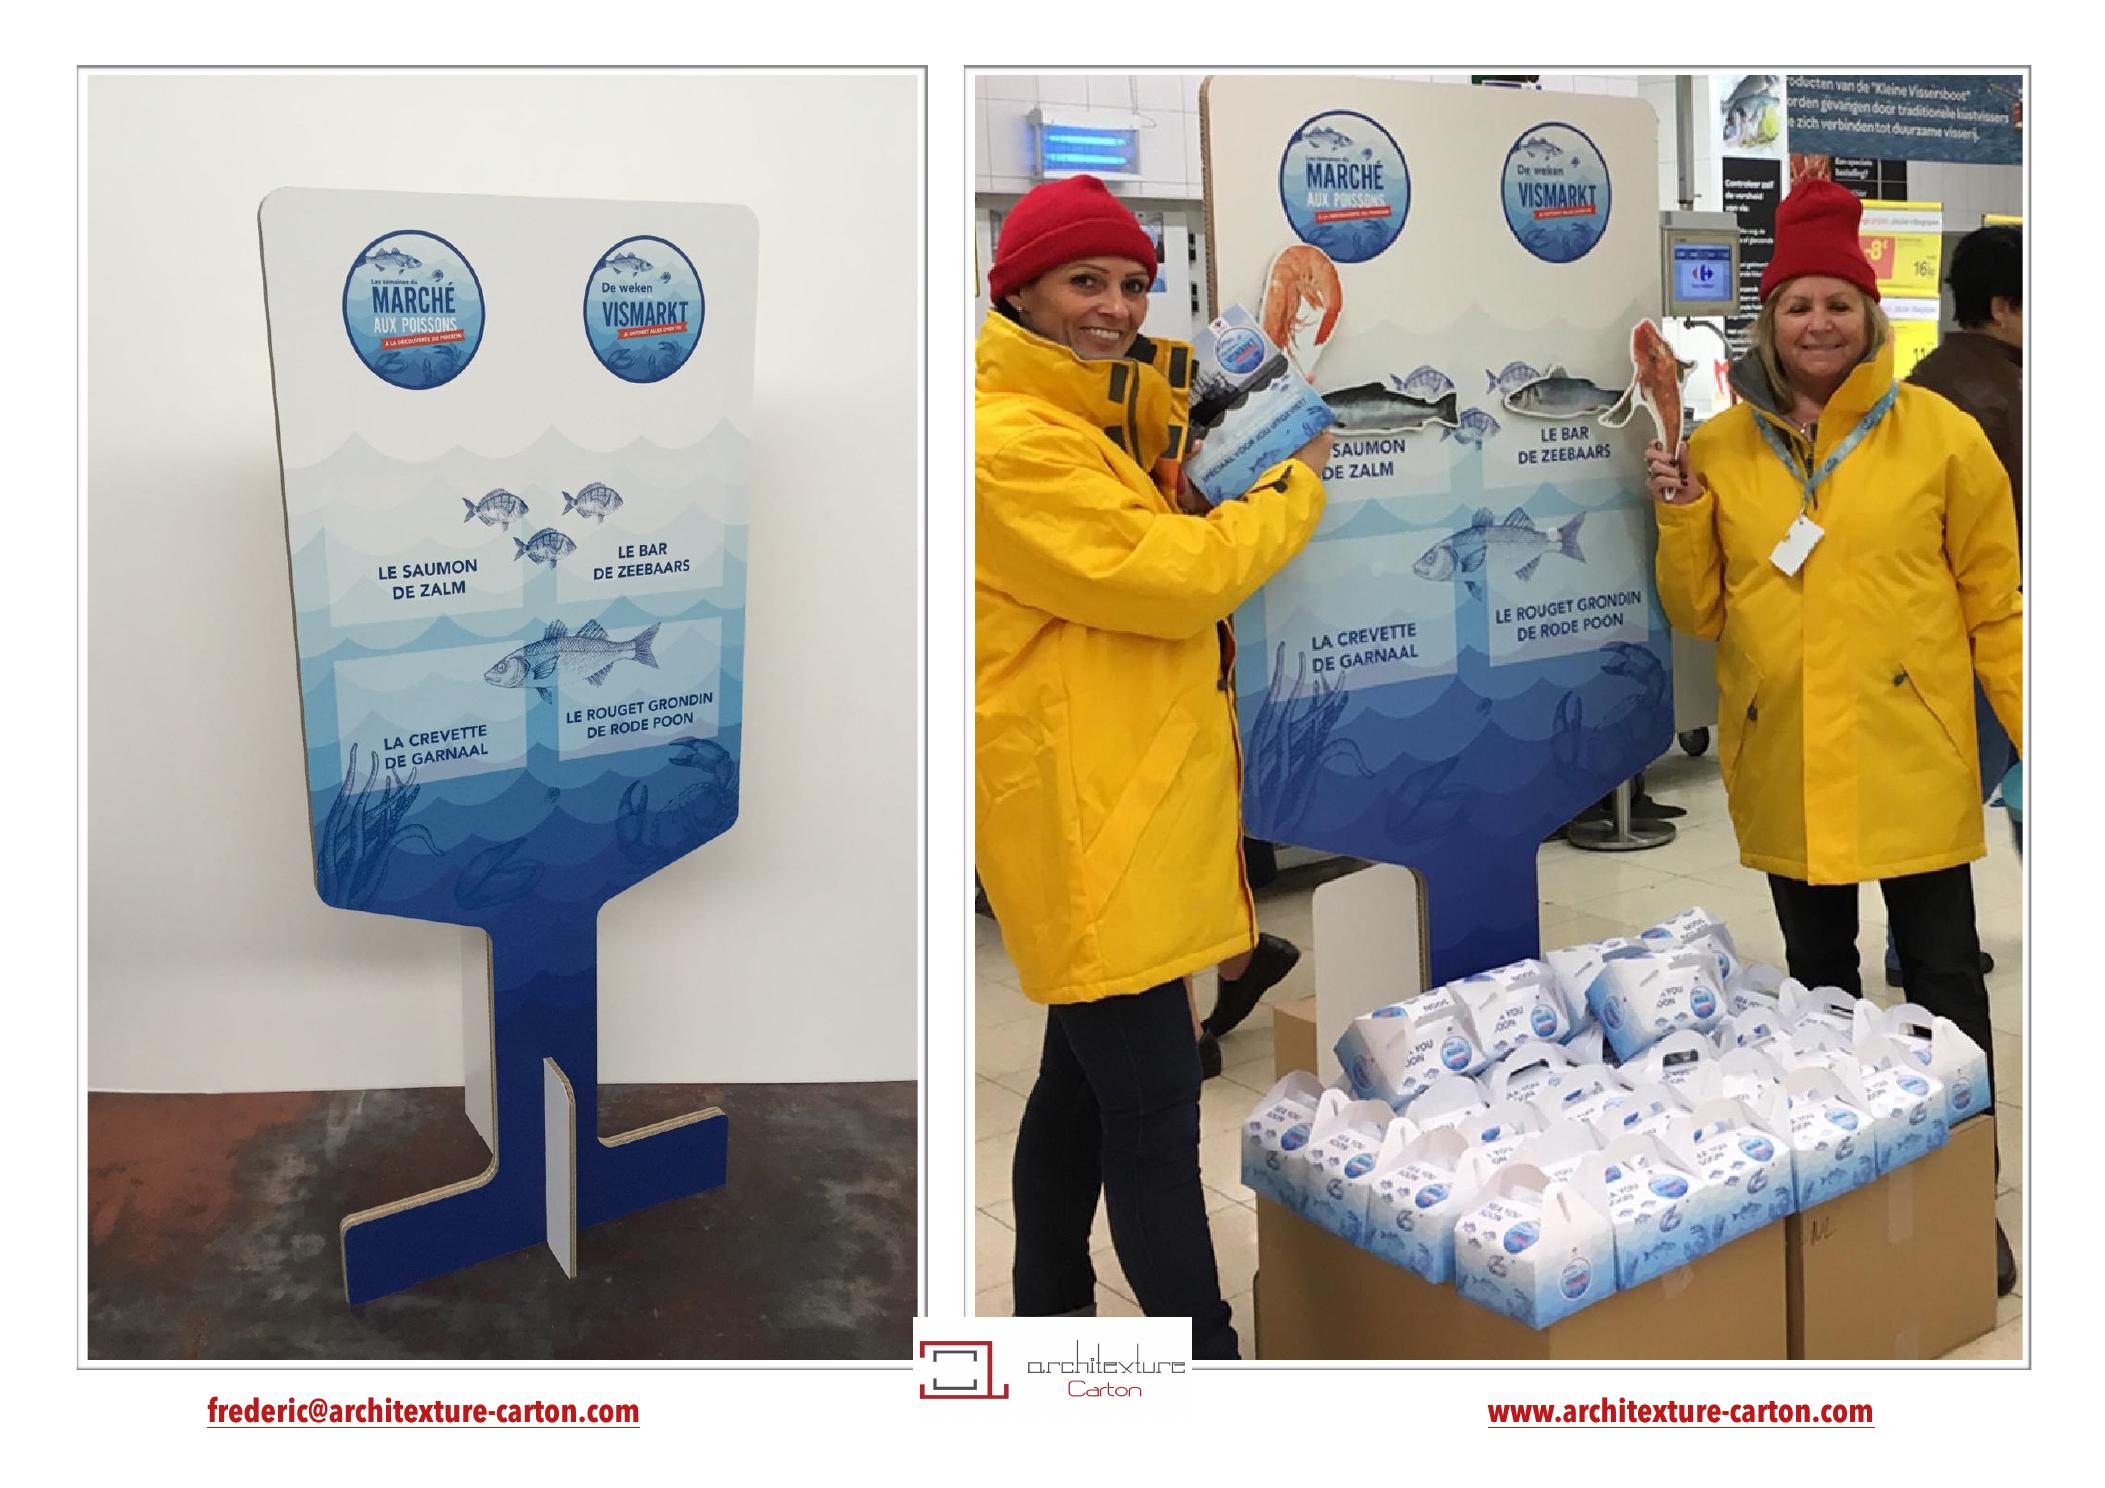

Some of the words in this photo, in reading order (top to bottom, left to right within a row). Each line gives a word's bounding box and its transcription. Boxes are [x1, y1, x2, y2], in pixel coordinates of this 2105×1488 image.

[1837, 82, 1854, 92] van
[1856, 80, 1869, 94] de
[1820, 98, 1871, 115] gevangen
[1871, 101, 1895, 114] door
[1797, 116, 1819, 129] zich
[1821, 118, 1874, 132] verbinden
[1875, 122, 1890, 133] tot
[1891, 122, 1942, 137] duurzame
[1307, 161, 1384, 190] MARCHÉ
[1517, 164, 1531, 175] De
[1534, 165, 1564, 176] weken
[1307, 192, 1330, 207] AUX
[1334, 191, 1385, 208] POISSONS
[1518, 182, 1597, 208] VISMARKT
[372, 282, 456, 313] MARCHÉ
[602, 282, 616, 293] De
[619, 282, 653, 293] weken
[602, 301, 688, 327] VISMARKT
[374, 317, 397, 333] AUX
[402, 317, 457, 333] POISSONS
[1541, 428, 1557, 442] LE
[1562, 426, 1589, 441] BAR
[1332, 439, 1406, 459] SAUMON
[1518, 450, 1538, 465] DE
[1541, 443, 1611, 463] ZEEBAARS
[1322, 464, 1344, 480] DE
[1349, 461, 1394, 478] ZALM
[618, 545, 635, 559] LE
[639, 543, 668, 557] BAR
[378, 566, 397, 580] LE
[402, 559, 477, 579] SAUMON
[593, 567, 613, 580] DE
[617, 559, 690, 578] ZEEBAARS
[393, 585, 415, 600] DE
[420, 580, 466, 597] ZALM
[1495, 608, 1511, 624] LE
[1517, 599, 1573, 620] ROUGET
[1577, 591, 1641, 611] GRONDIN
[1312, 634, 1333, 651] LA
[1337, 623, 1416, 647] CREVETTE
[1517, 625, 1536, 642] DE
[1540, 620, 1578, 638] RODE
[1584, 613, 1624, 631] POON
[1312, 657, 1335, 673] DE
[1340, 644, 1419, 668] GARNAAL
[566, 711, 582, 724] LE
[587, 701, 645, 721] ROUGET
[648, 692, 713, 712] GRONDIN
[587, 726, 606, 739] DE
[610, 719, 648, 736] RODE
[653, 712, 694, 729] POON
[384, 737, 404, 750] LA
[409, 725, 487, 747] CREVETTE
[385, 755, 406, 769] DE
[412, 743, 488, 765] GARNAAL
